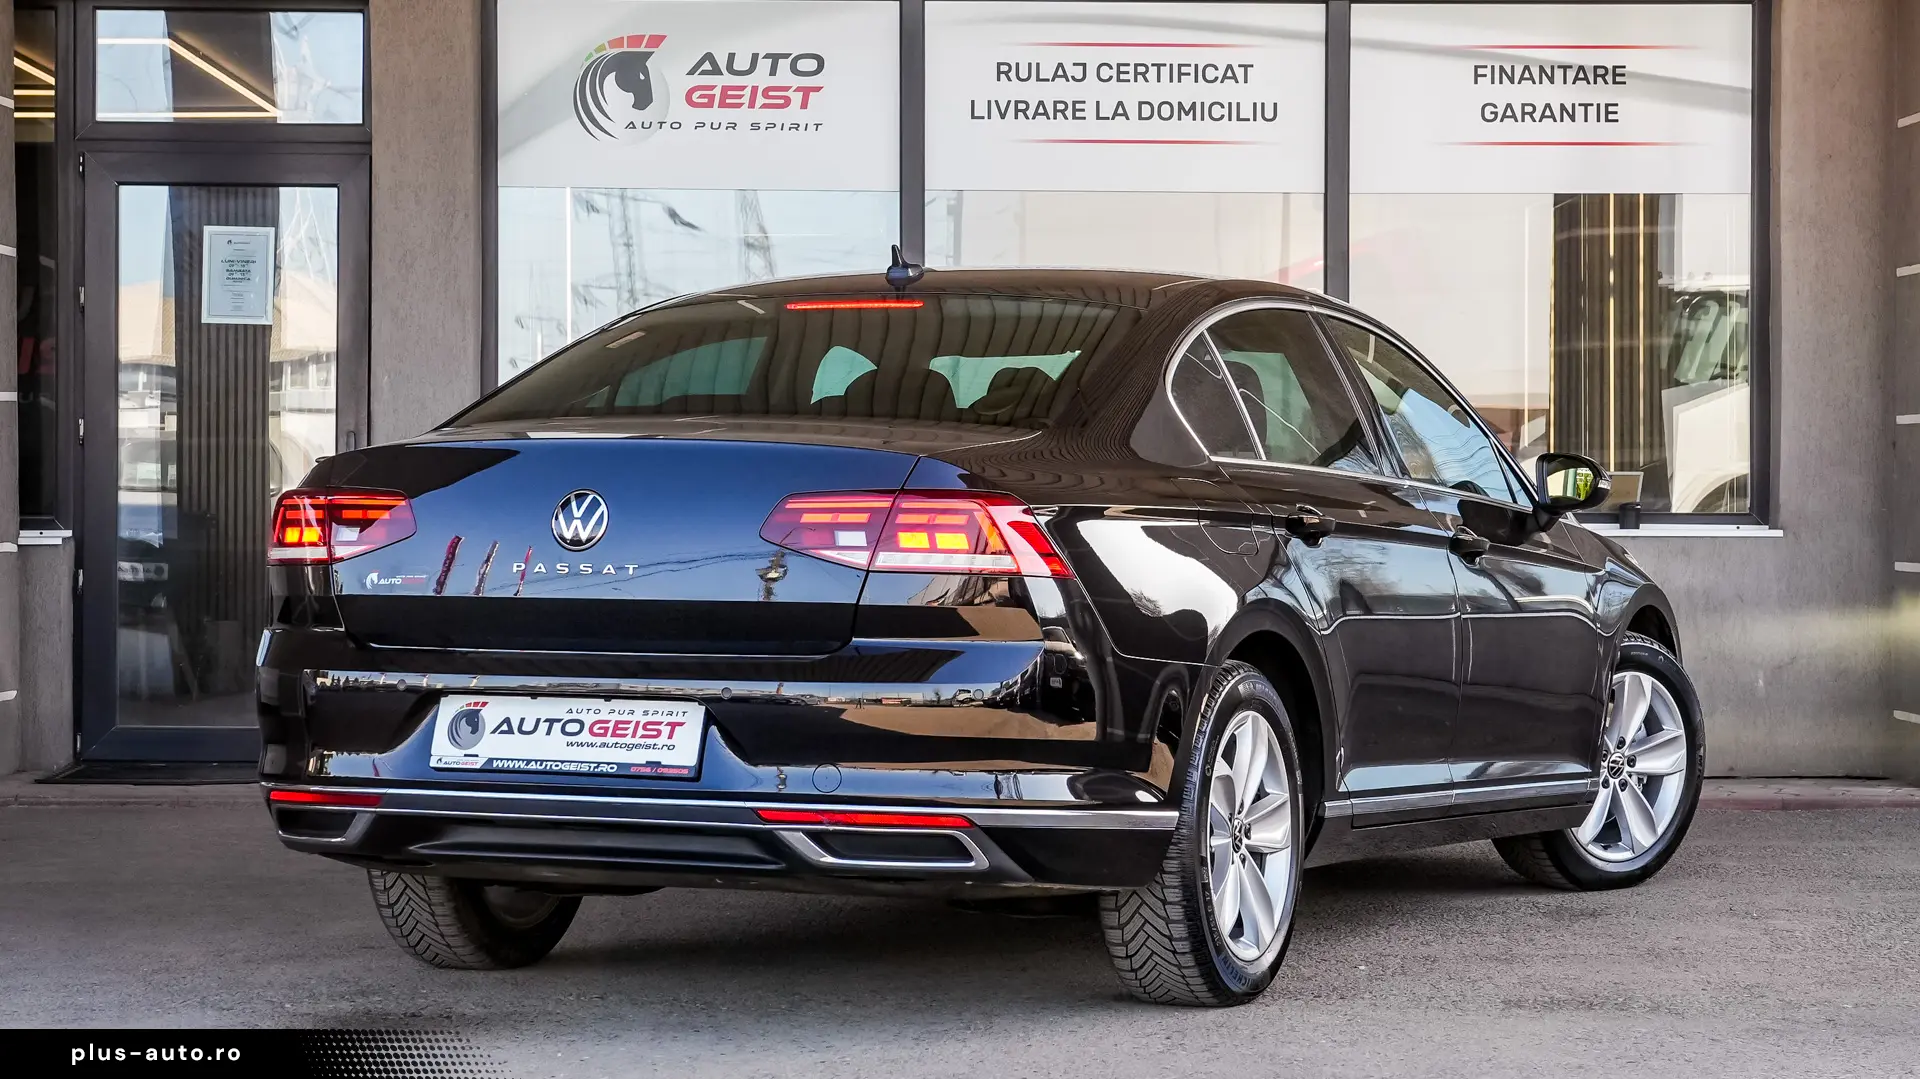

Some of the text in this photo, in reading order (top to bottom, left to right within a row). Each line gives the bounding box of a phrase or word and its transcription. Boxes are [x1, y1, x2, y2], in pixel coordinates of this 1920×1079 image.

[685, 51, 825, 77] AUTO
[996, 62, 1254, 84] RULAJ CERTIFICAT
[1473, 64, 1627, 85] FINANTARE
[684, 84, 824, 110] GEIST
[970, 99, 1278, 123] LIVRARE LA DOMICILIU
[1480, 102, 1619, 123] GARANTIE
[624, 120, 824, 132] AUTO PUR SPIRIT
[512, 562, 639, 575] PASSAT
[565, 740, 676, 752] www.autogeist.ro
[492, 758, 618, 773] WWW.AUTOGEIST.RO
